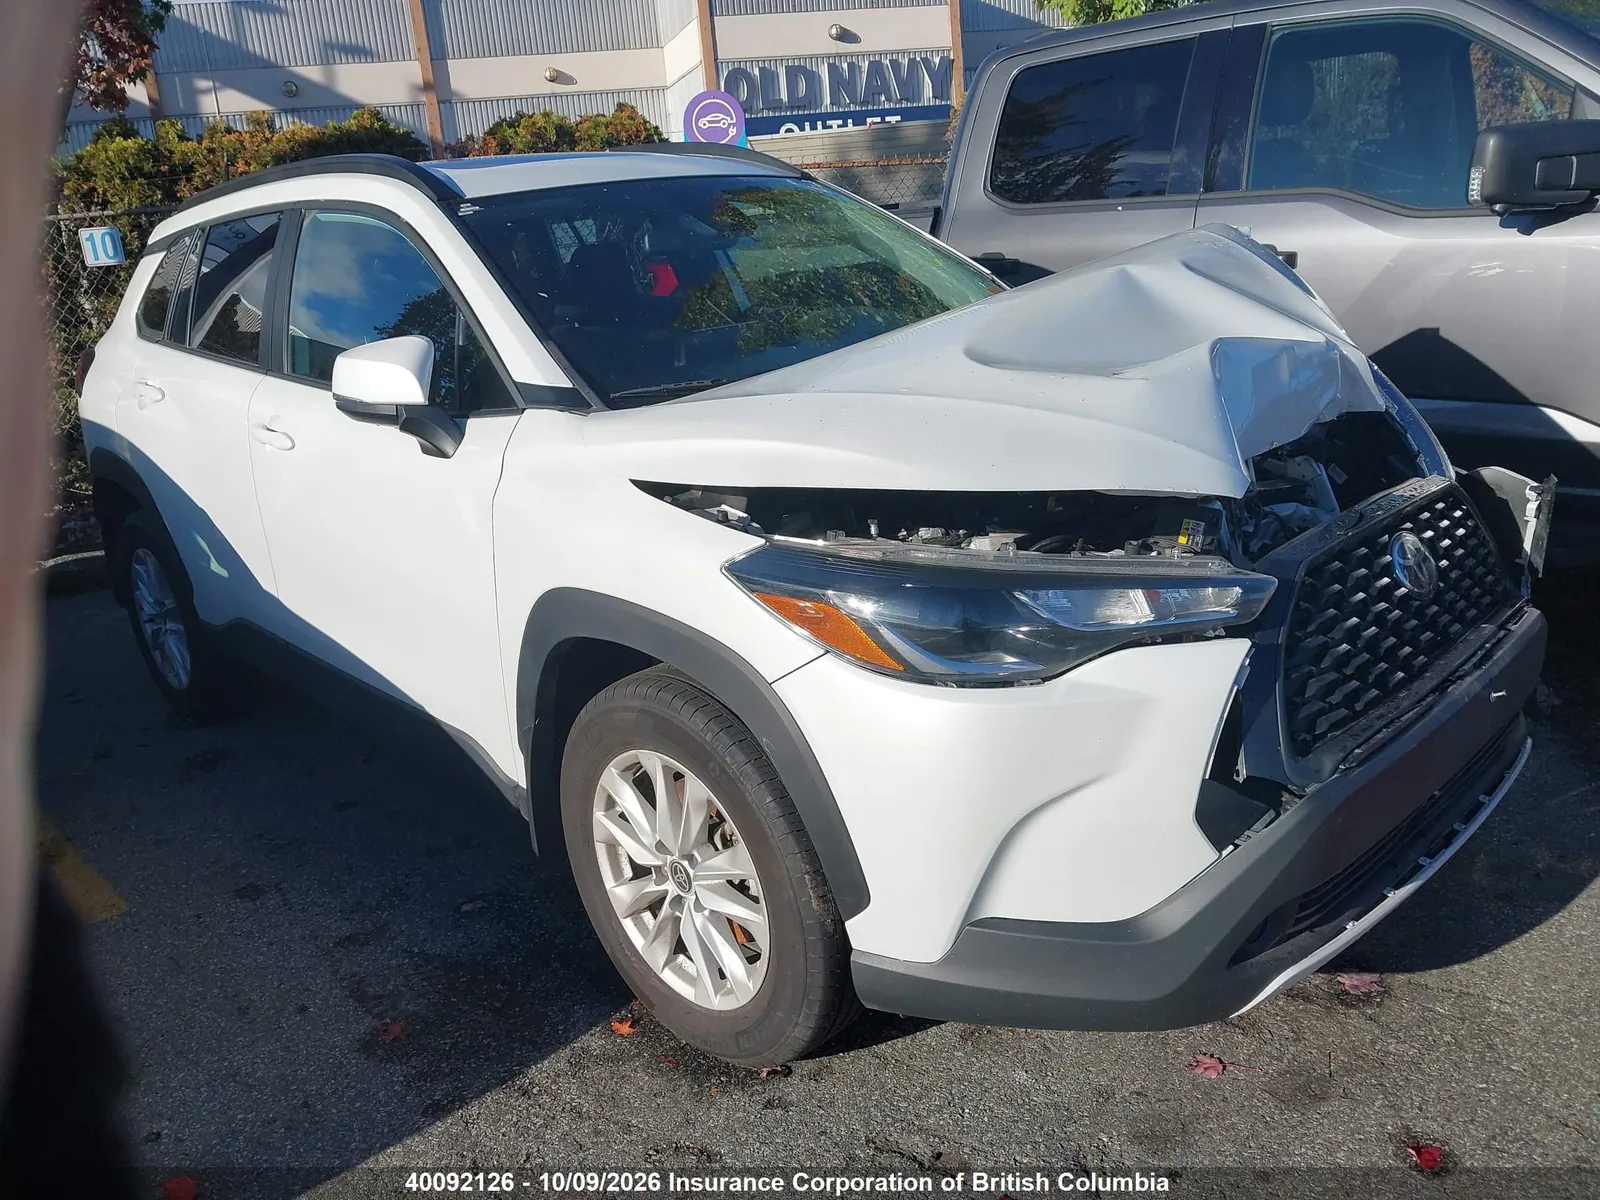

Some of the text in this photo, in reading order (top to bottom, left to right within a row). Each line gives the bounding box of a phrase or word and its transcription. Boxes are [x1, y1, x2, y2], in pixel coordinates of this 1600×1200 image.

[723, 56, 953, 110] OLD NAVY
[84, 231, 119, 261] 10
